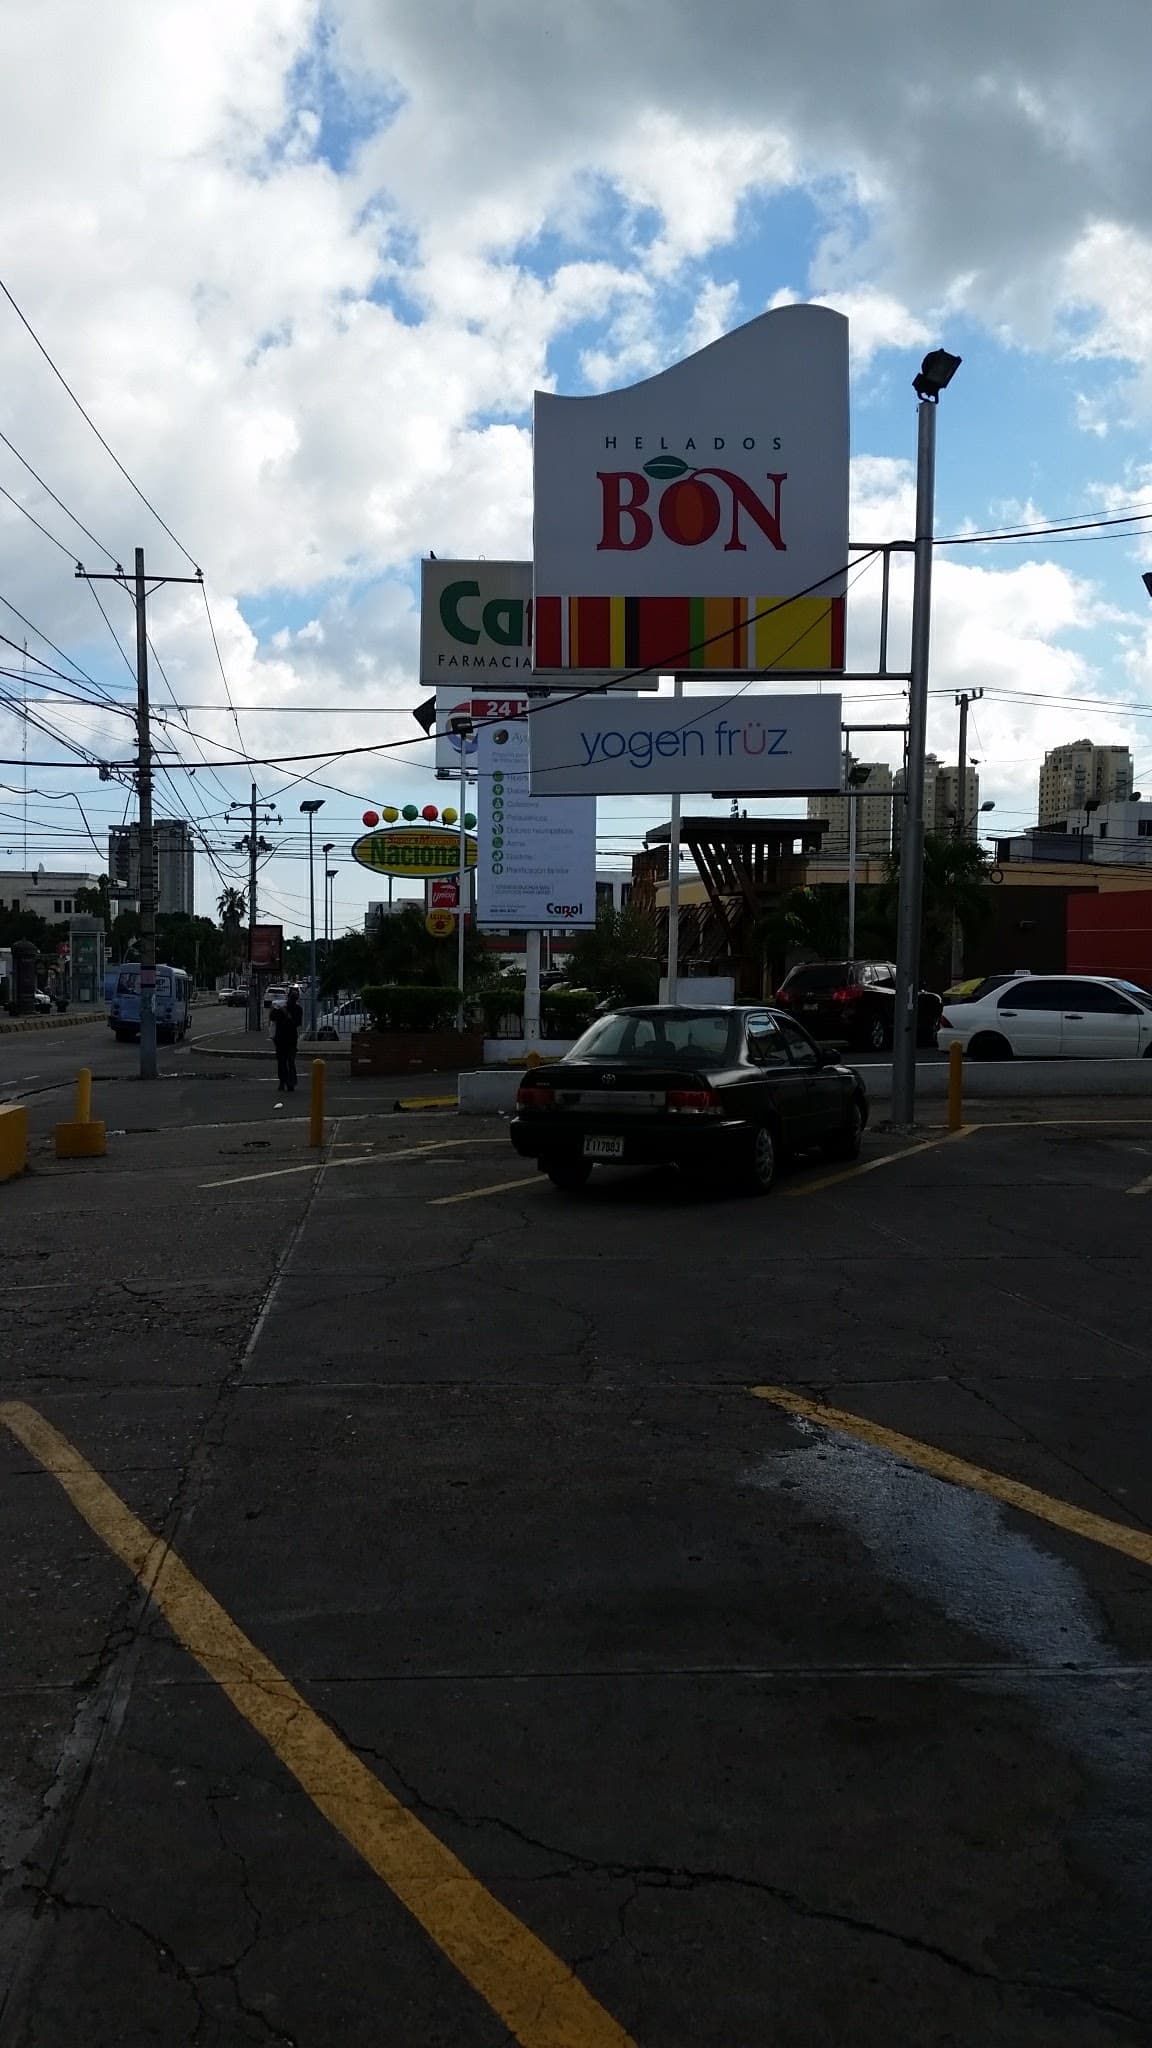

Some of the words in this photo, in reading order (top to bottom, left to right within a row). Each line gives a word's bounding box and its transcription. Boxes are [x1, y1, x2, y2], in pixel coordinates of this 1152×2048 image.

[605, 437, 782, 450] HELADOS
[597, 467, 788, 551] BON
[486, 701, 511, 716] 24
[580, 730, 704, 768] yogen
[715, 719, 790, 756] früz
